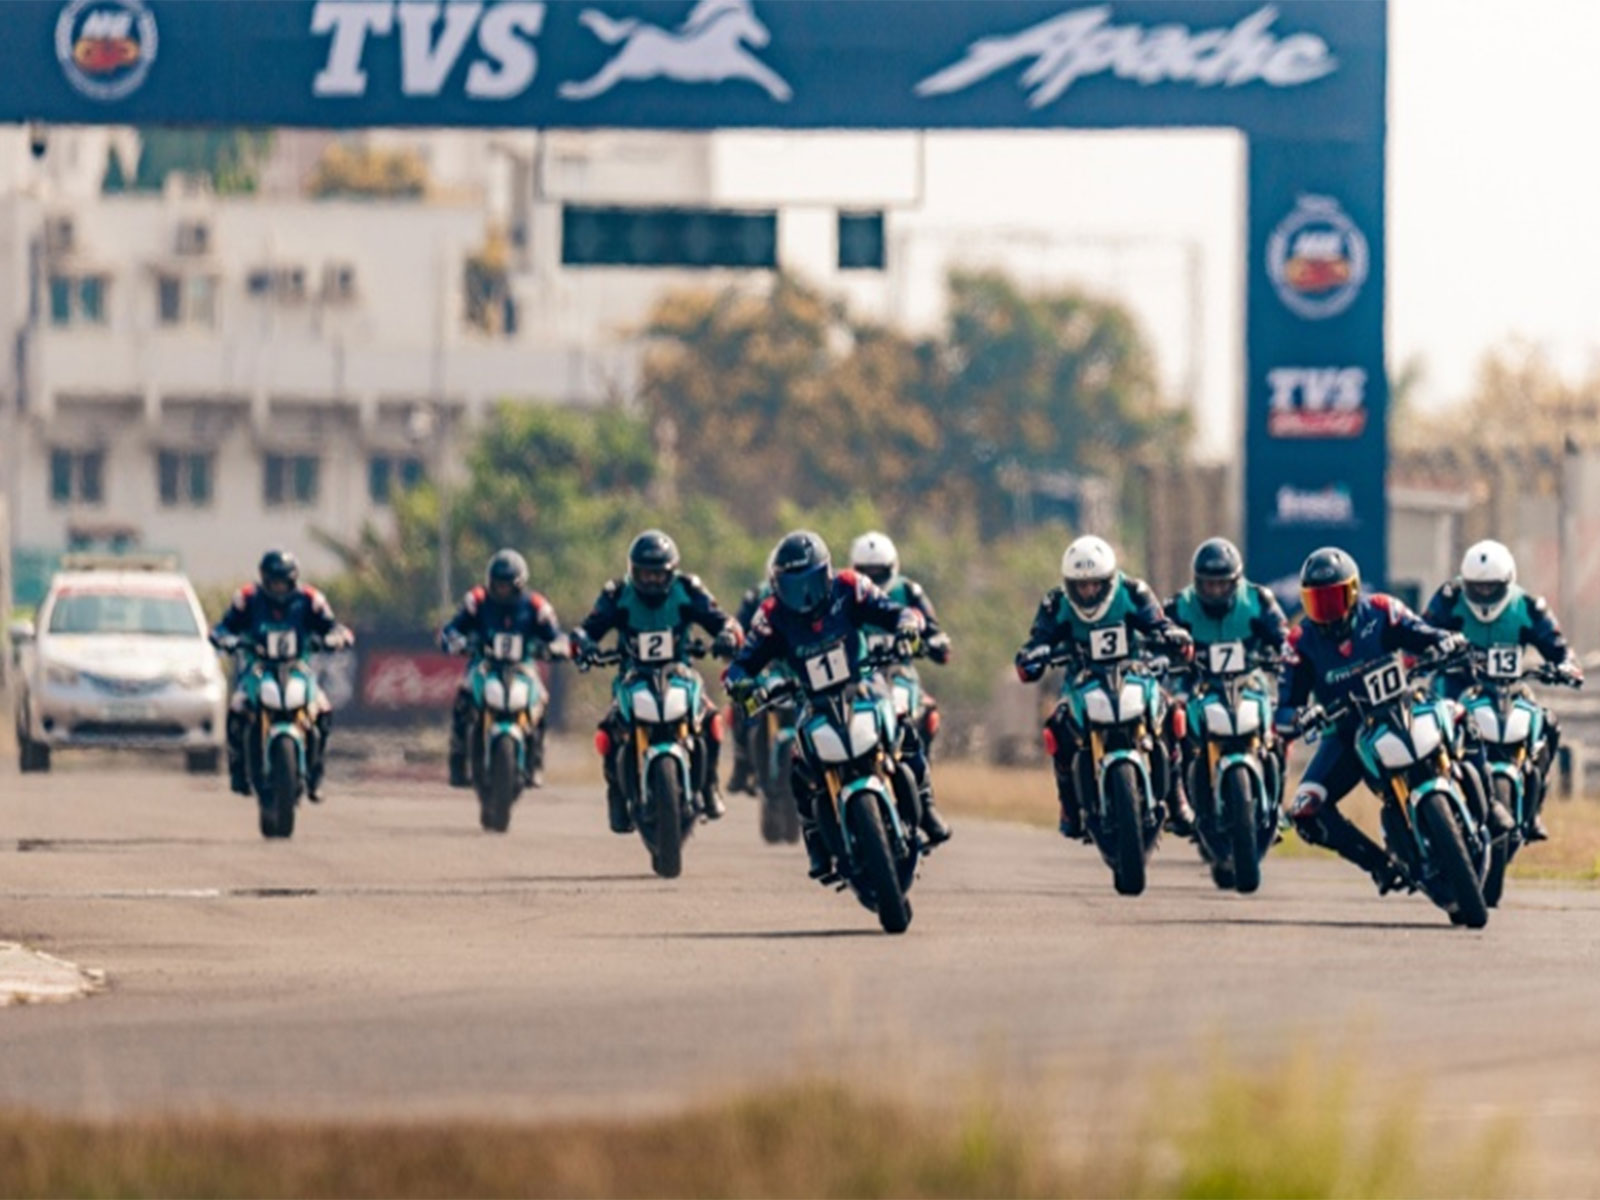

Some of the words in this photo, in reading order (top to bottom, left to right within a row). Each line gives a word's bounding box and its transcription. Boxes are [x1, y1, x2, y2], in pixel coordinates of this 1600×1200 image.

[310, 0, 544, 99] TVS
[914, 3, 1338, 109] Apache
[1267, 366, 1366, 410] TVS
[648, 634, 663, 657] 2
[1100, 631, 1118, 656] 3
[815, 654, 834, 681] 1
[1219, 646, 1233, 671] 7
[1492, 651, 1518, 673] 13
[1368, 665, 1402, 701] 10
